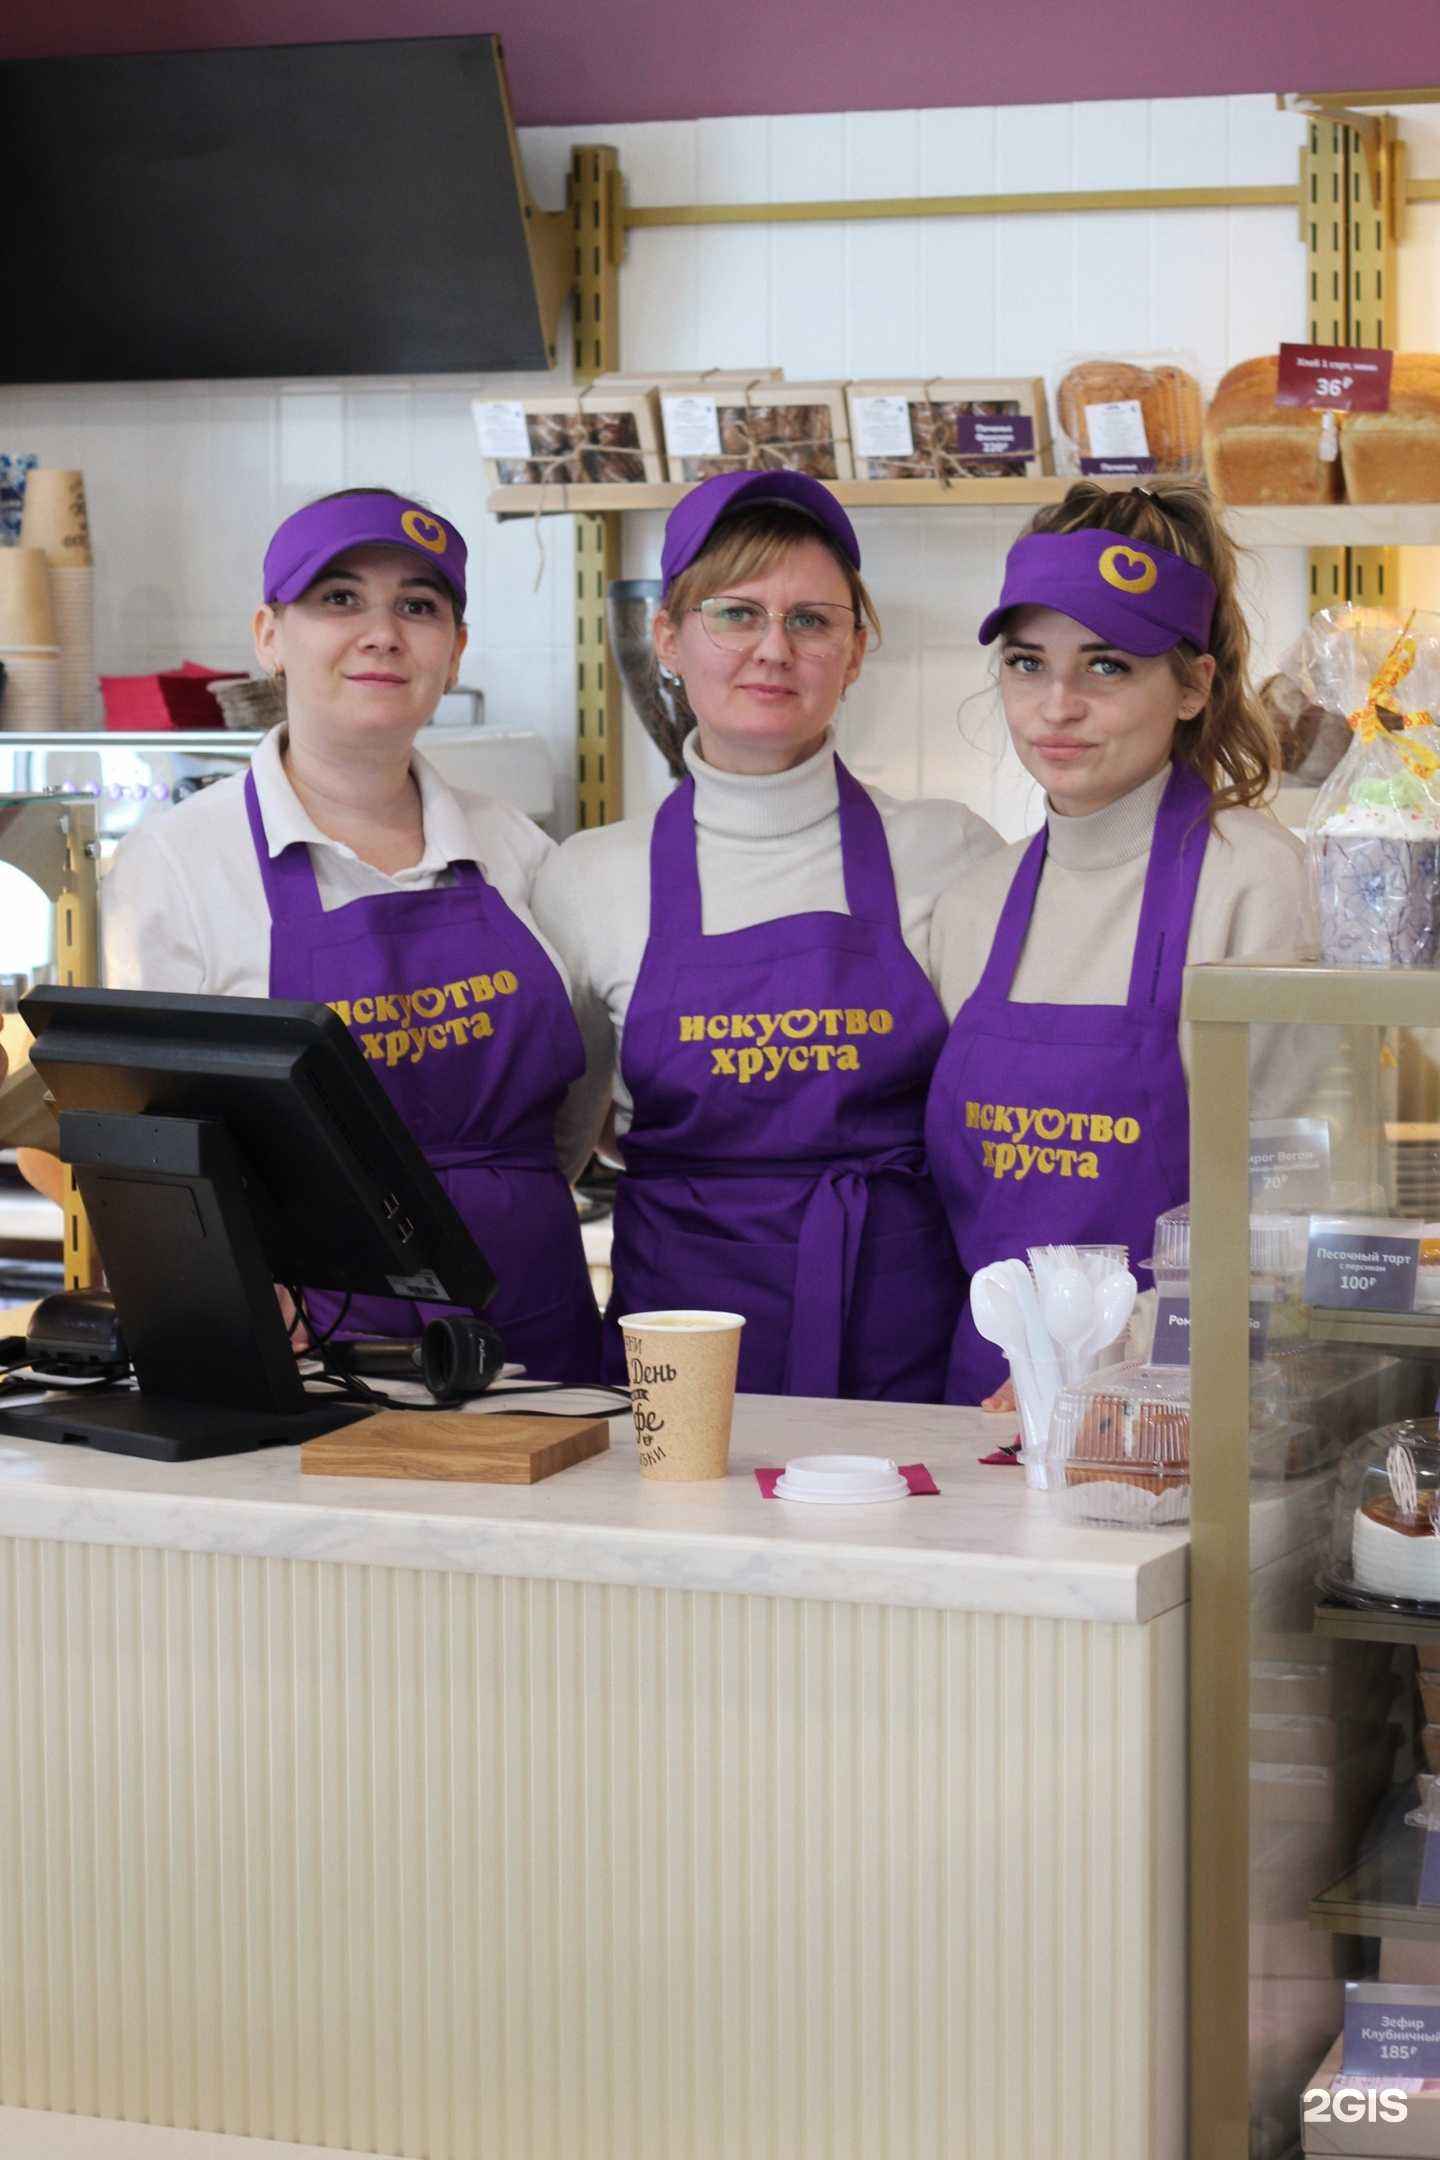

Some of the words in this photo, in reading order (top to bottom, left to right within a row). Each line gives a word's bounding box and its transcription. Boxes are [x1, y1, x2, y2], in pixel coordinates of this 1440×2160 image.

[360, 1011, 494, 1067] хруста
[711, 1044, 860, 1083] хруста
[1316, 1248, 1379, 1262] Песочный
[1383, 1254, 1412, 1266] тарт
[632, 1358, 677, 1384] День
[1380, 2016, 1424, 2031] Зефир
